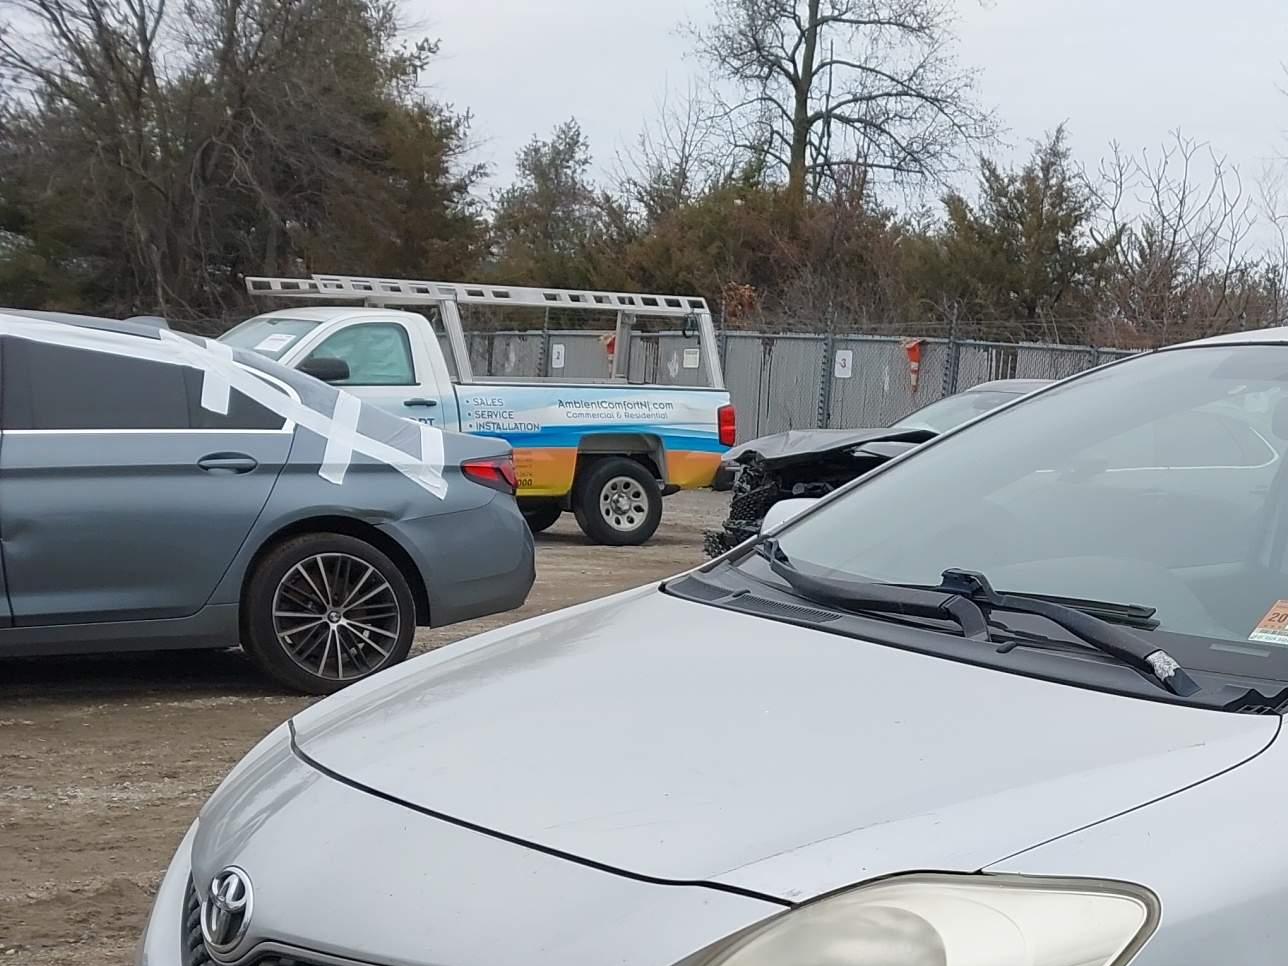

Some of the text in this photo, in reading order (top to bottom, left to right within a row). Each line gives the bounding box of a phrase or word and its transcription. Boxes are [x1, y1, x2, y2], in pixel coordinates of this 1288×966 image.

[473, 398, 504, 407] SALES
[558, 399, 675, 412] AmbientComfortNJ.com
[475, 410, 515, 419] SERVICE
[566, 411, 615, 419] Commercial
[624, 411, 669, 419] Residential
[476, 421, 540, 431] INSTALLATION
[1267, 612, 1288, 623] 20
